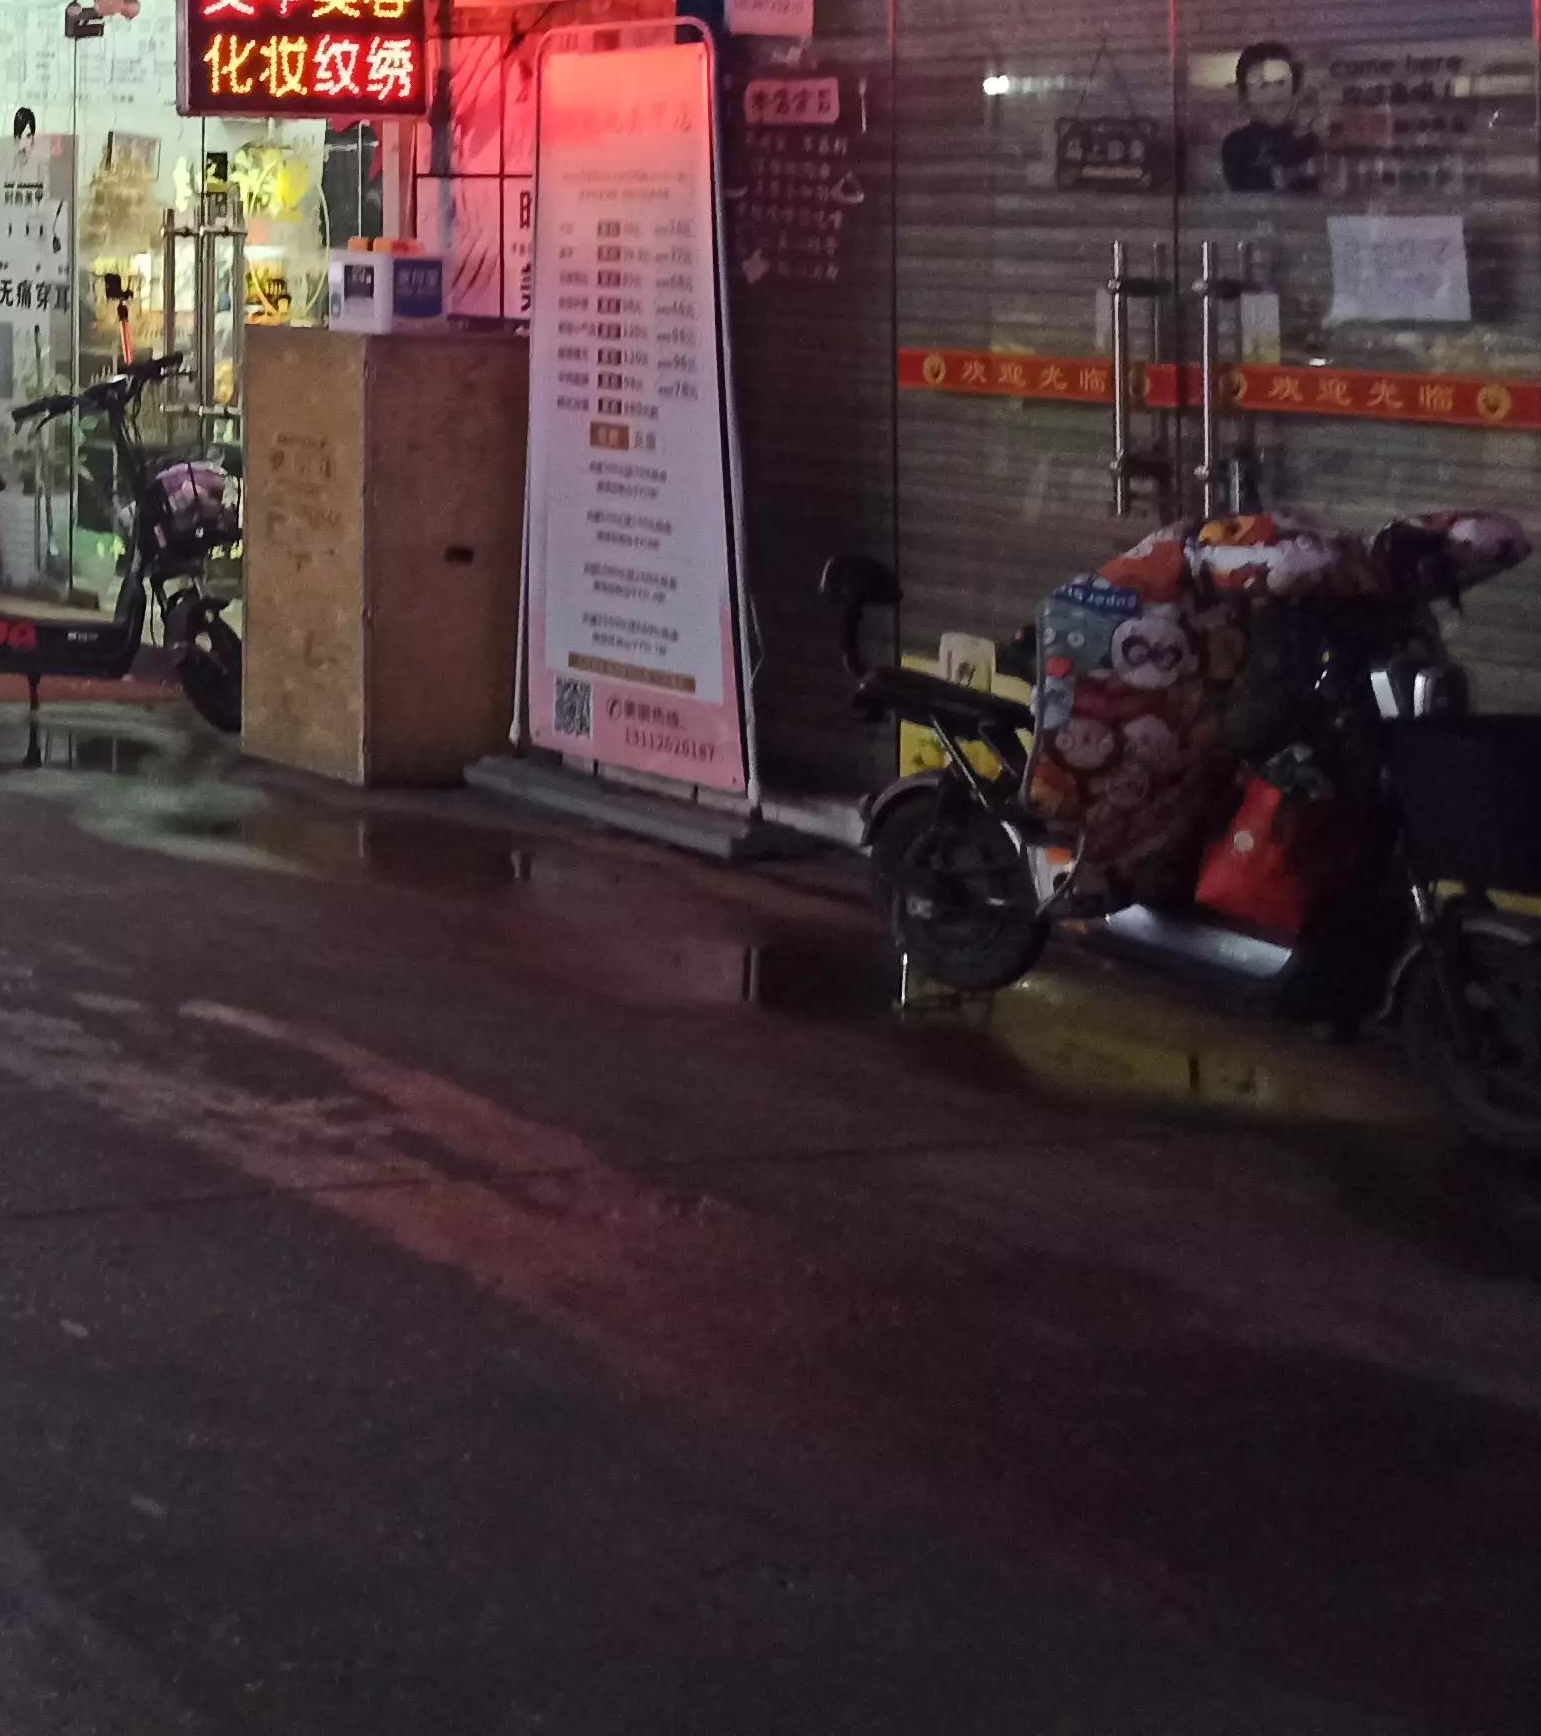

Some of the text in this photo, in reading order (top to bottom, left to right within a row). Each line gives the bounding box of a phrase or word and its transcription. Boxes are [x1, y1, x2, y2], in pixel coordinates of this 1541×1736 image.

[202, 33, 414, 101] 化妆纹绣
[960, 358, 1107, 394] 欢迎光临
[1267, 375, 1455, 414] 欢迎光临
